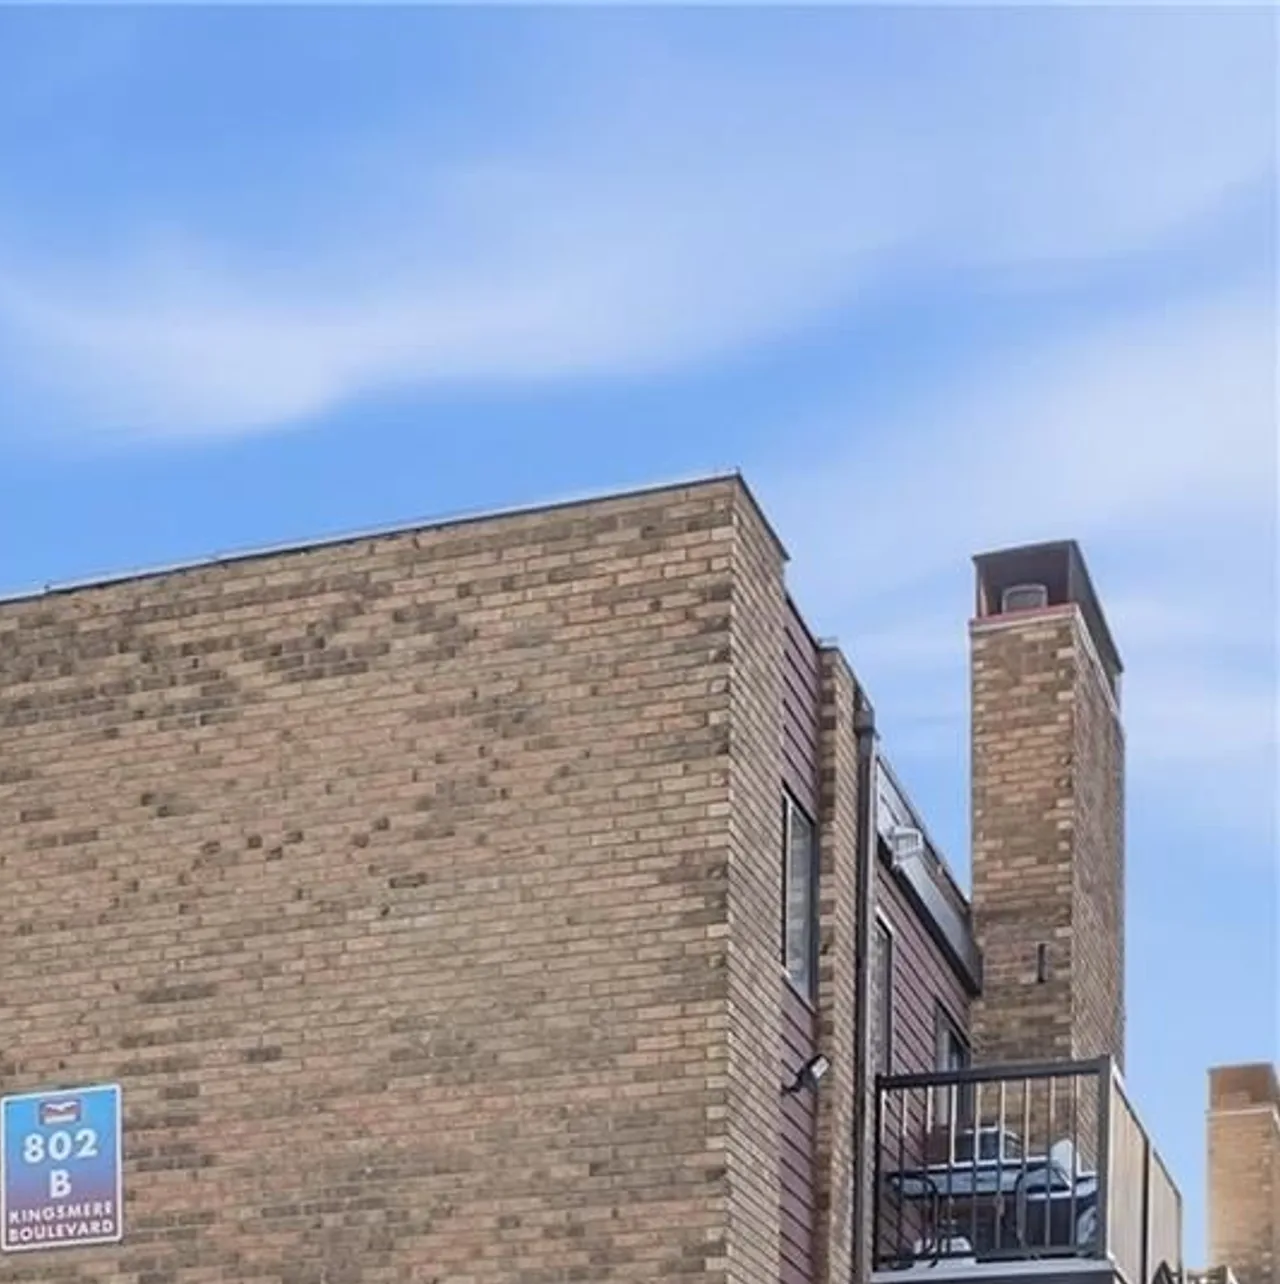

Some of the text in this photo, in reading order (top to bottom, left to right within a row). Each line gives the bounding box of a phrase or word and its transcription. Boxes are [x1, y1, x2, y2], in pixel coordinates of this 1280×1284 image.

[23, 1128, 99, 1164] 802
[50, 1168, 72, 1199] B
[8, 1200, 114, 1225] KINGSMERE
[7, 1219, 115, 1243] BOULEVARD
